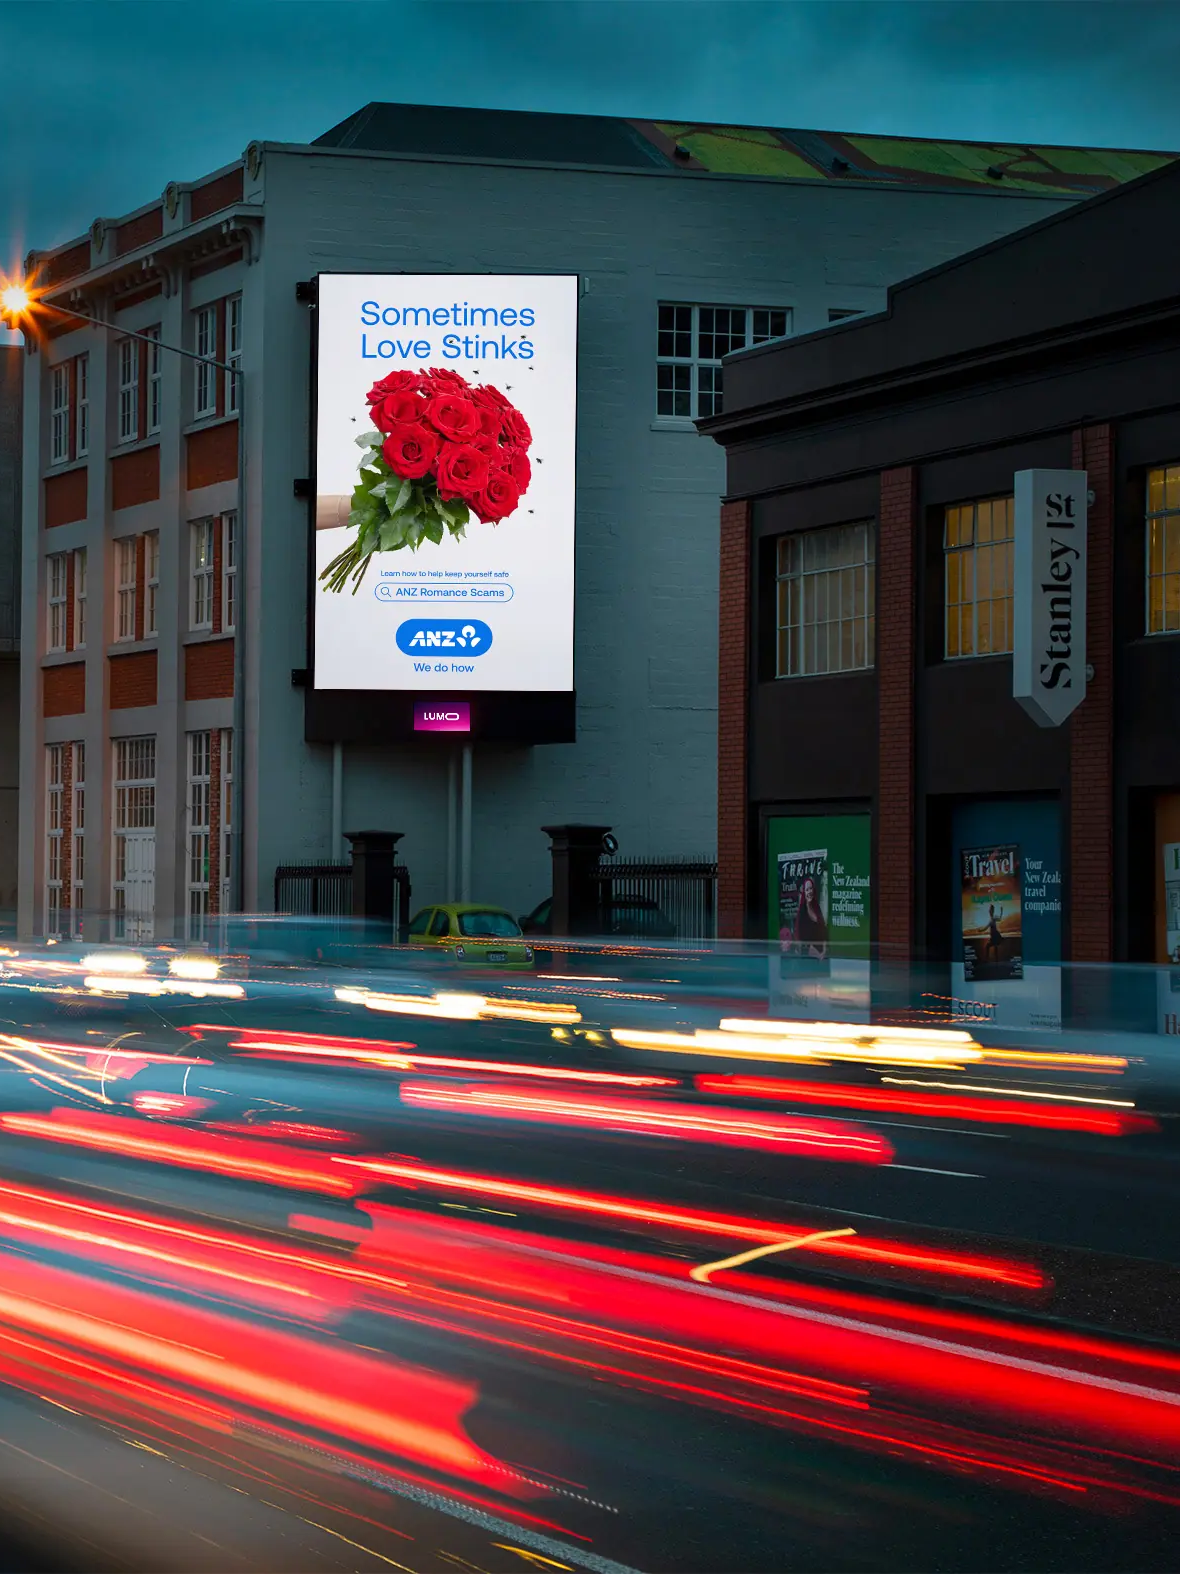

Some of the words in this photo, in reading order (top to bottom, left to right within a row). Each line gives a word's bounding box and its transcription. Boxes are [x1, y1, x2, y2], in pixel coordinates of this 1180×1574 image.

[361, 301, 535, 327] Sometimes
[361, 334, 431, 359] Love
[442, 334, 534, 360] Stinks
[1045, 492, 1076, 519] St
[380, 570, 400, 578] Learn
[401, 570, 418, 578] how
[419, 570, 427, 578] to
[427, 570, 443, 579] help
[445, 570, 462, 579] keep
[464, 570, 492, 579] yourself
[494, 570, 509, 578] safe
[396, 587, 418, 597] ANZ
[420, 587, 467, 597] Romance
[470, 587, 505, 597] Scams
[1040, 536, 1080, 689] Stanley
[408, 631, 456, 647] ANZ
[414, 663, 431, 673] We
[434, 663, 448, 673] do
[452, 663, 475, 673] how
[423, 712, 460, 721] LUMO
[832, 863, 845, 874] The
[969, 852, 1014, 878] Travel
[1025, 857, 1043, 870] Your
[832, 875, 845, 887] New
[845, 875, 871, 887] Zealand
[1025, 871, 1041, 883] New
[832, 888, 862, 901] magazine
[1025, 885, 1046, 897] travel
[832, 901, 864, 915] redefining
